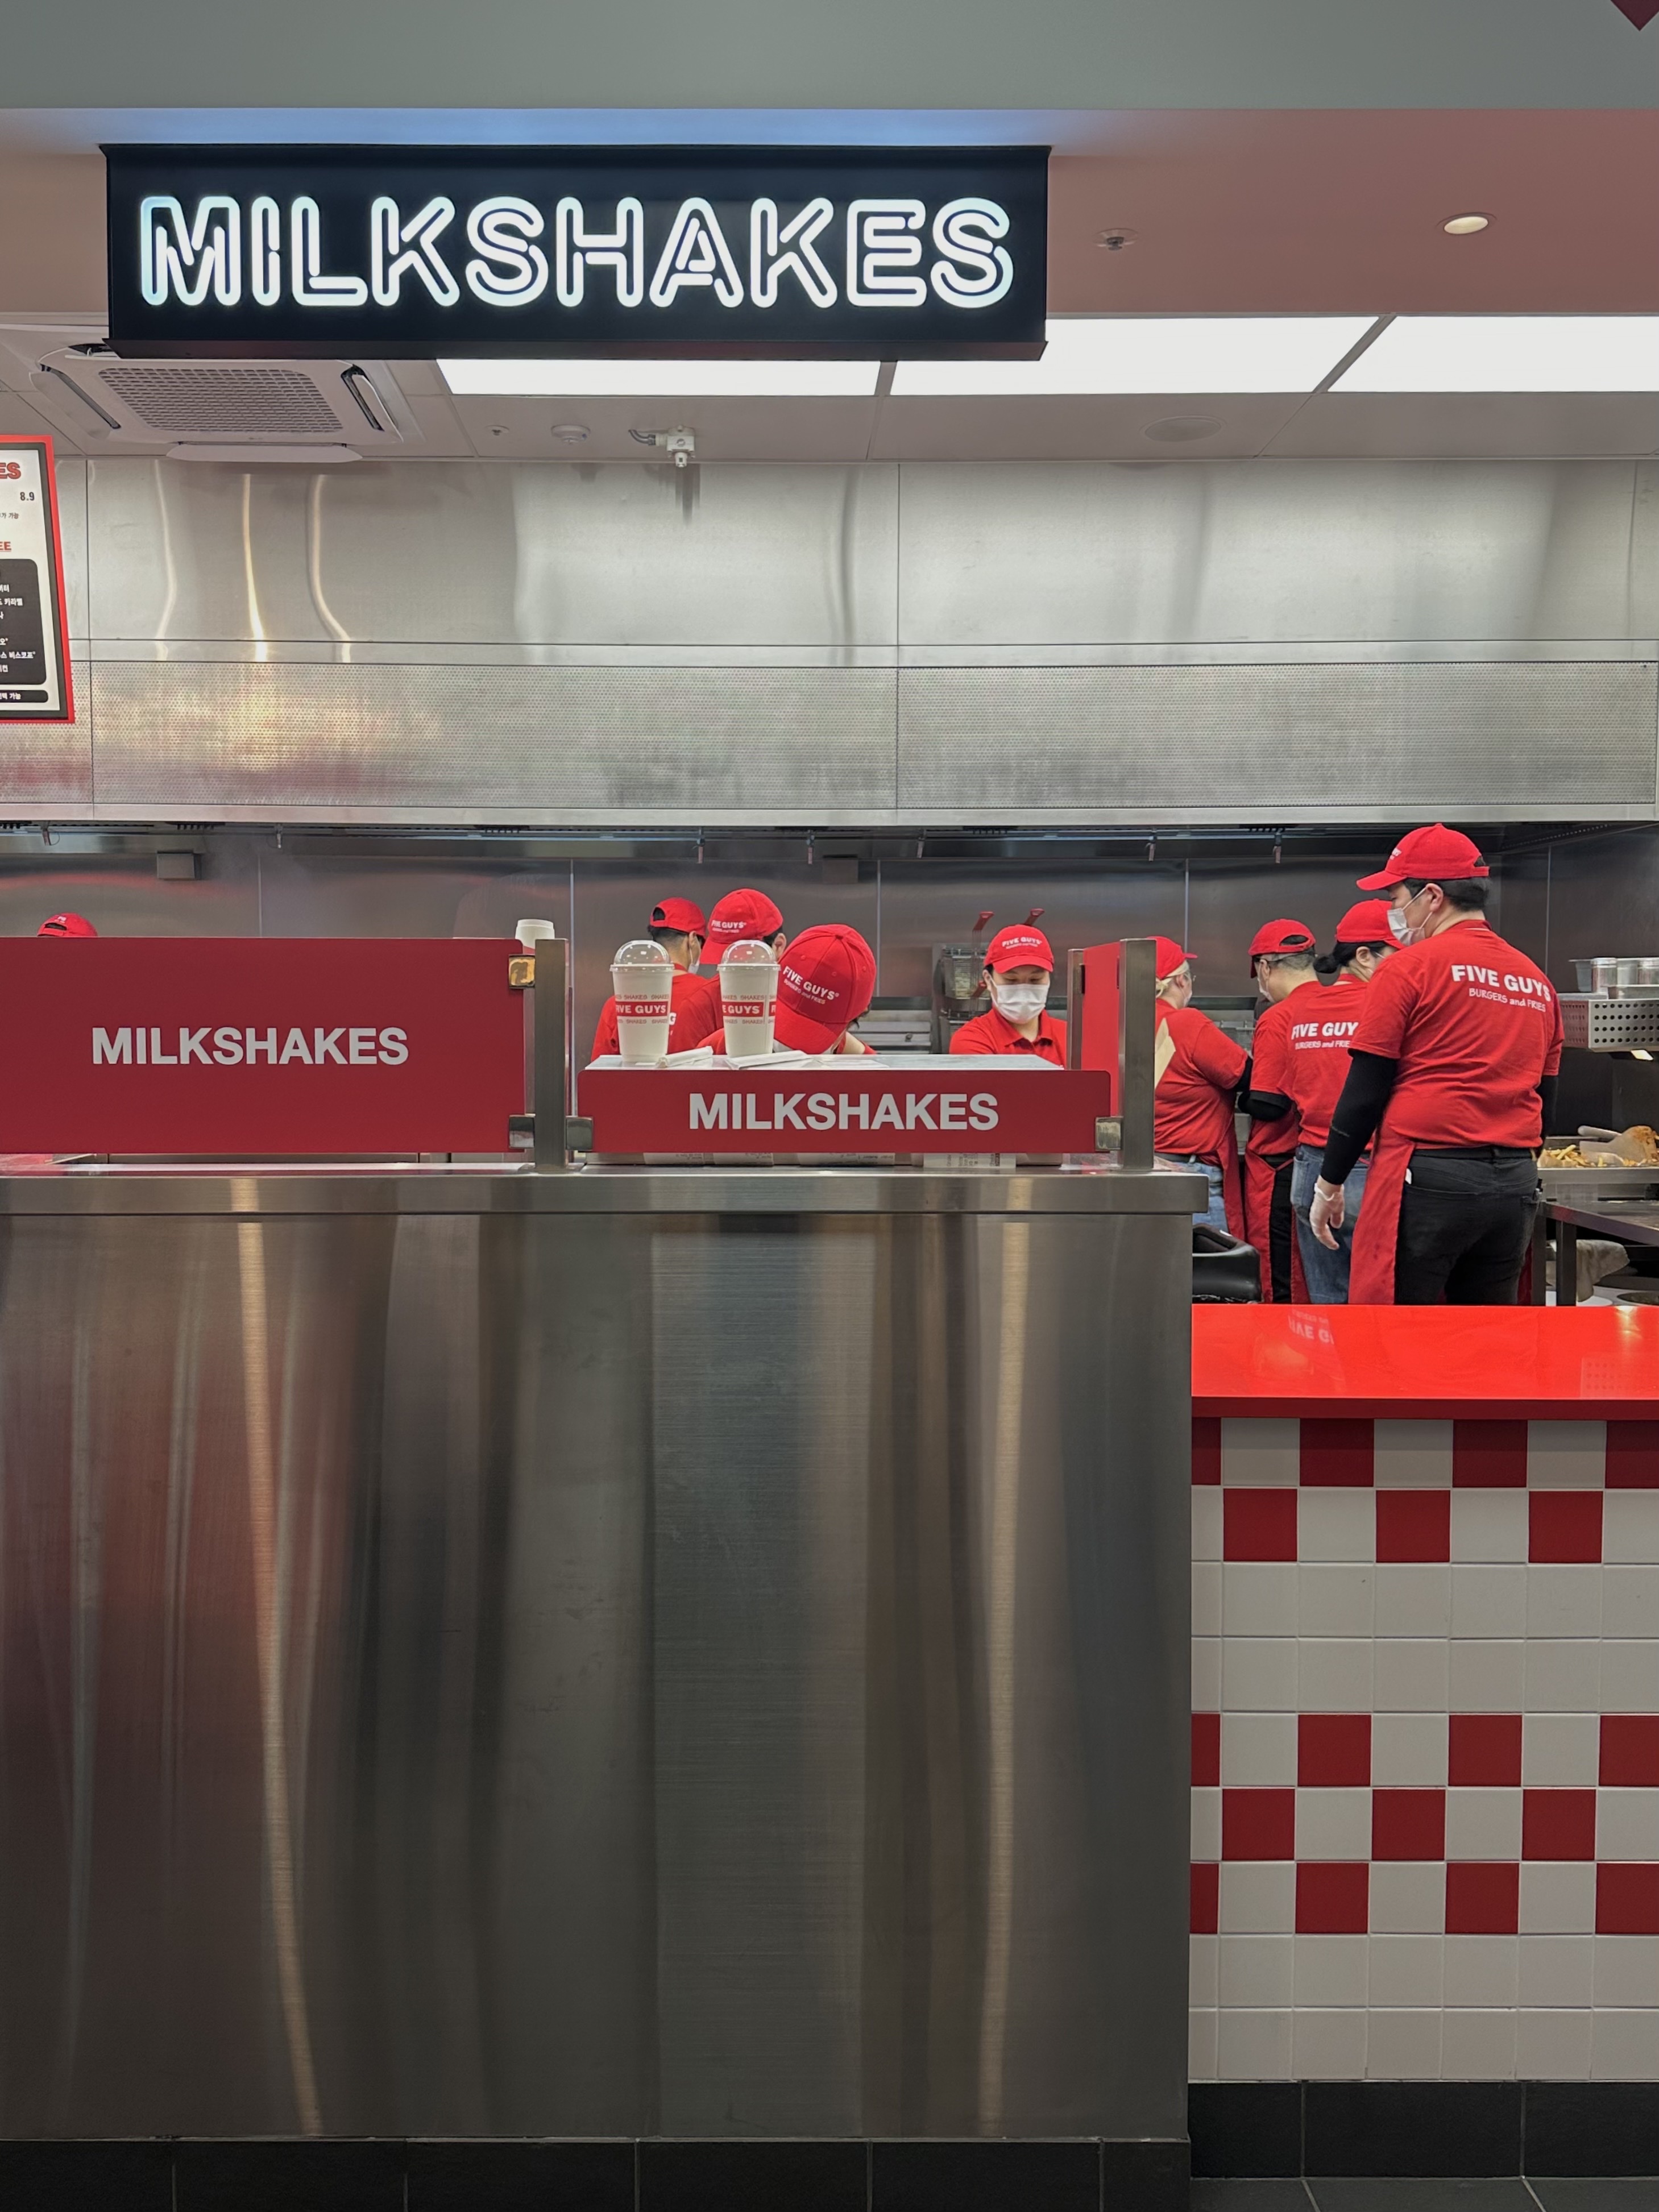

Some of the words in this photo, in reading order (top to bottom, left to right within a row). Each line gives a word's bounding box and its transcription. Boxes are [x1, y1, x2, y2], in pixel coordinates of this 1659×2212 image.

[140, 196, 1014, 308] MILKSHAKES
[20, 492, 35, 501] 8.9
[783, 966, 803, 985] FIVE
[1451, 965, 1500, 987] FIVE
[1503, 974, 1552, 1002] GUYS
[634, 1005, 666, 1014] GUYS
[728, 1005, 760, 1014] GUYS
[1469, 987, 1508, 1003] BURGERS
[1509, 998, 1527, 1007] and
[1527, 999, 1546, 1012] FRIES
[92, 1026, 408, 1065] MILKSHAKES
[689, 1092, 999, 1131] MILKSHAKES
